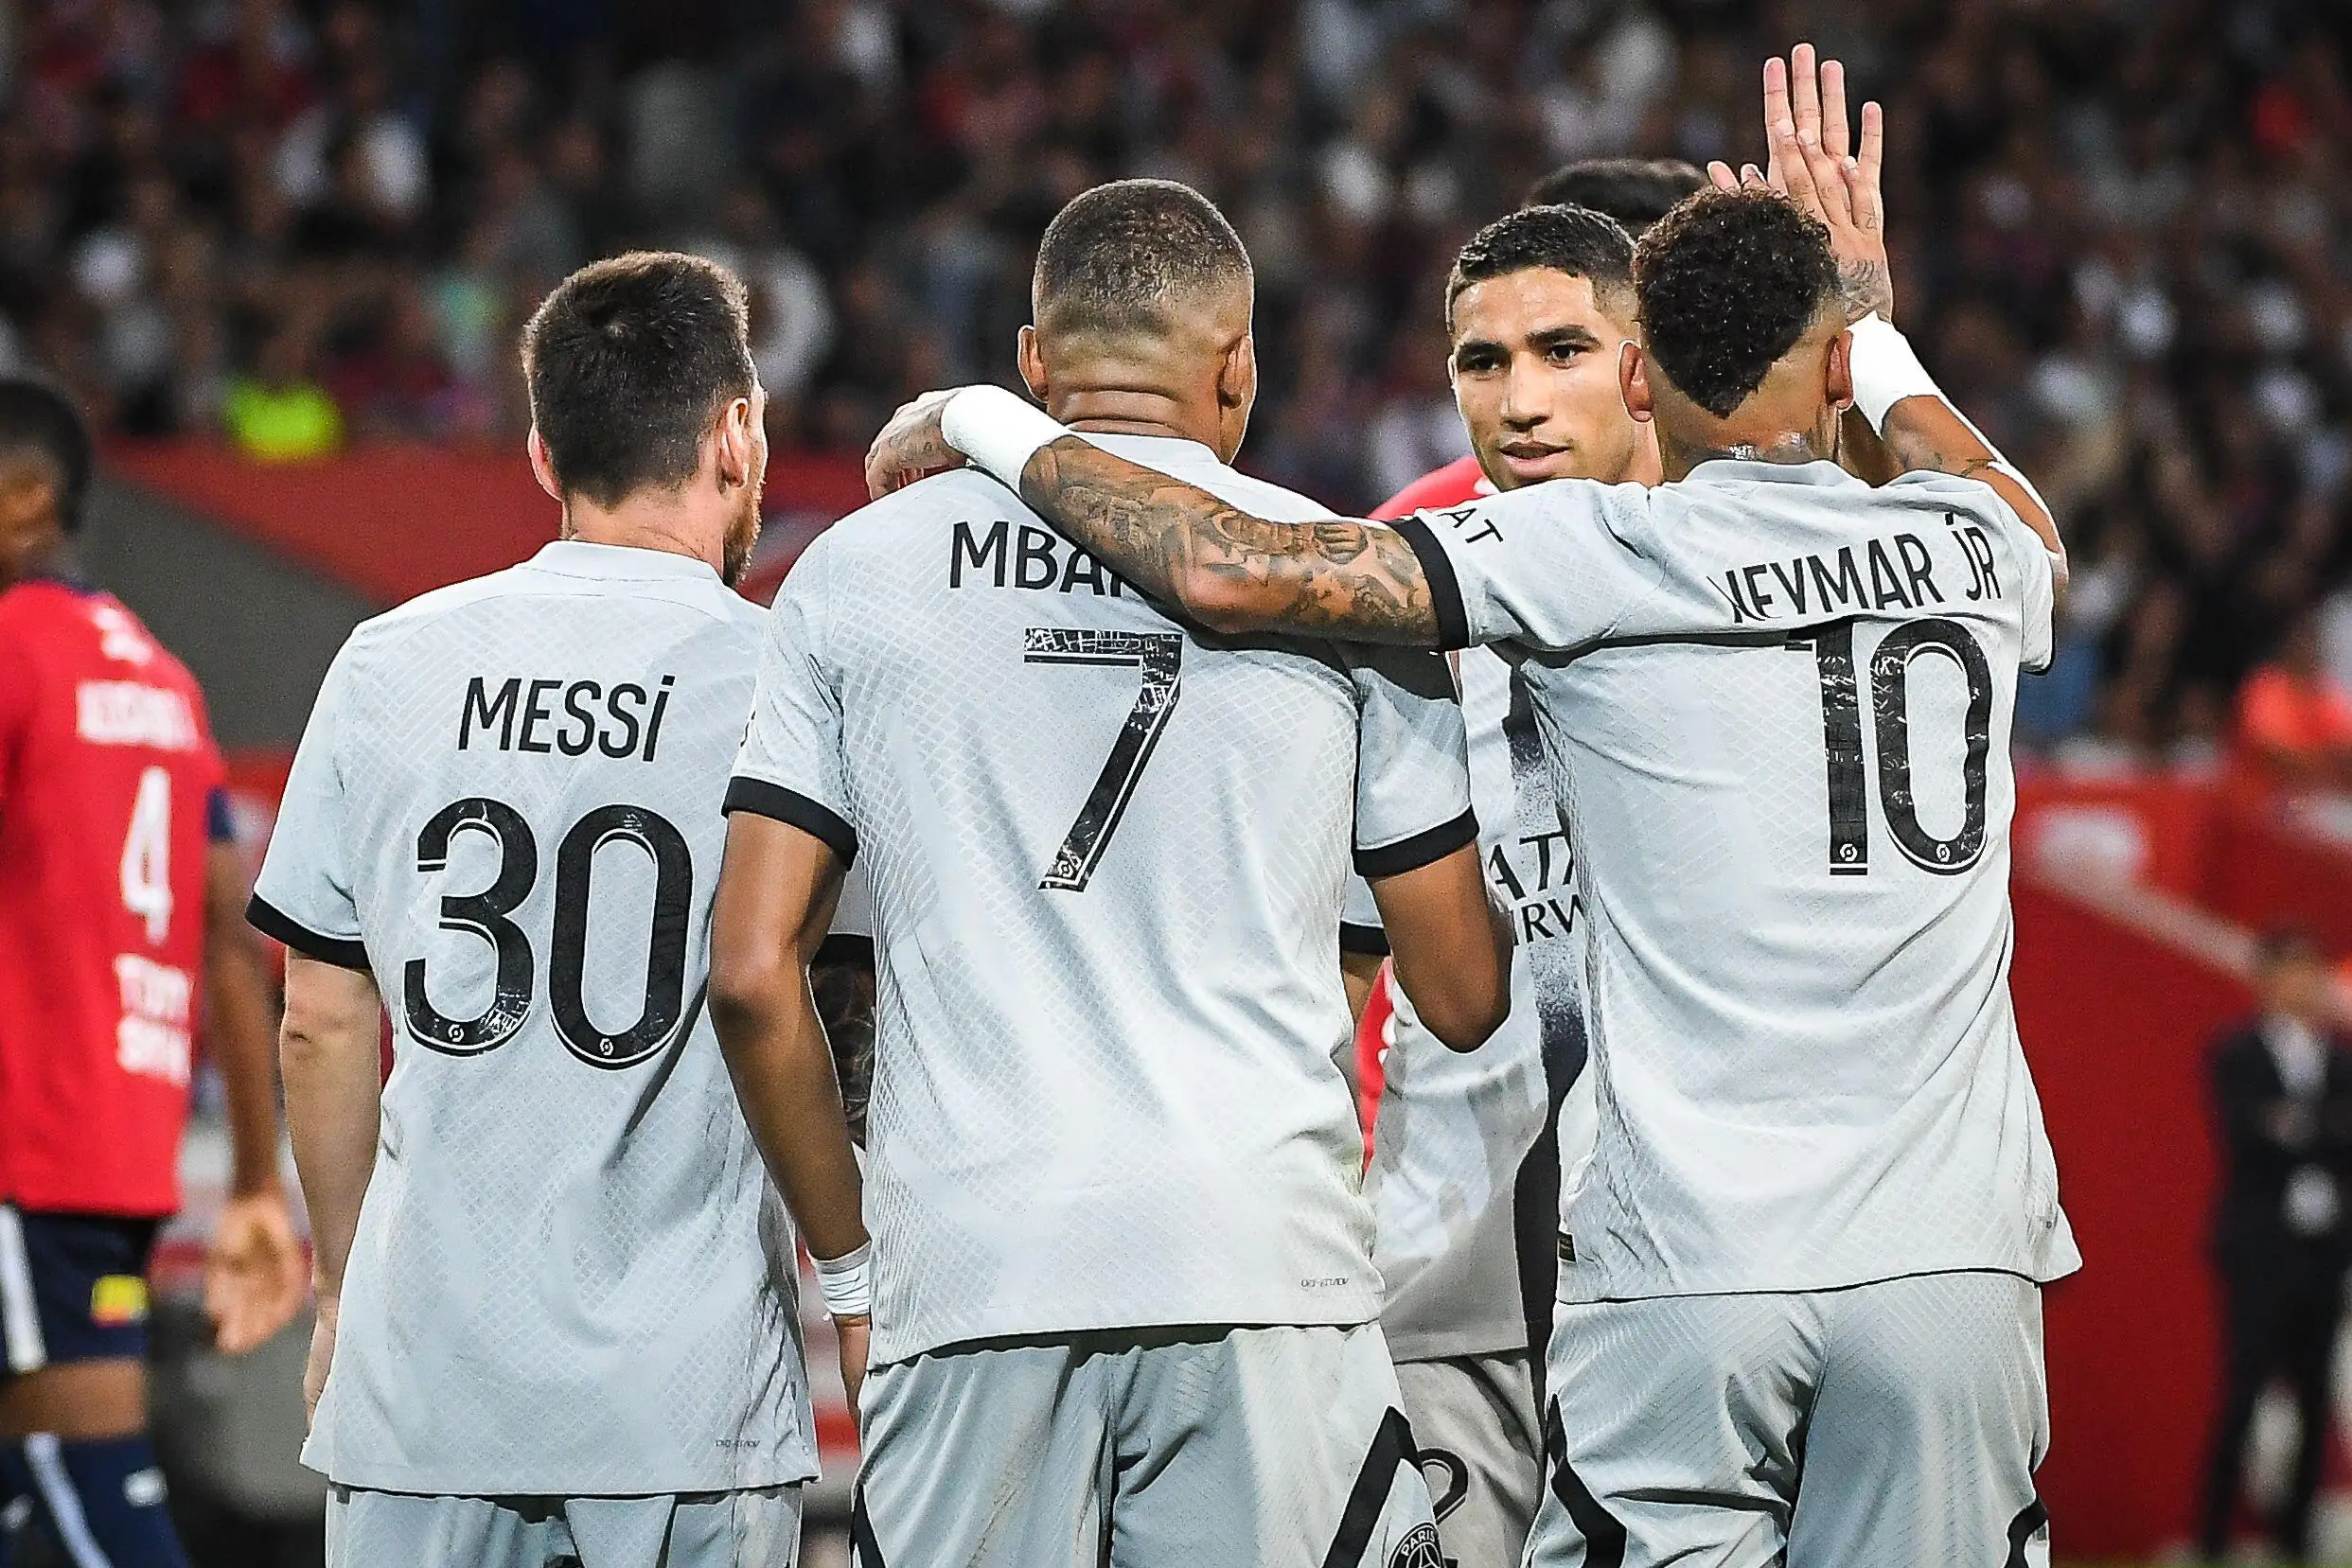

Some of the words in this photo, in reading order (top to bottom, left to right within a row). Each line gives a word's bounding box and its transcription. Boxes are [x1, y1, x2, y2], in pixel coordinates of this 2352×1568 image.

[949, 521, 1135, 598] MBA
[1023, 628, 1183, 893] 7
[1785, 617, 1991, 875] 10
[120, 766, 172, 945] 4
[403, 796, 694, 1071] 30
[1401, 1530, 1436, 1557] PARIS
